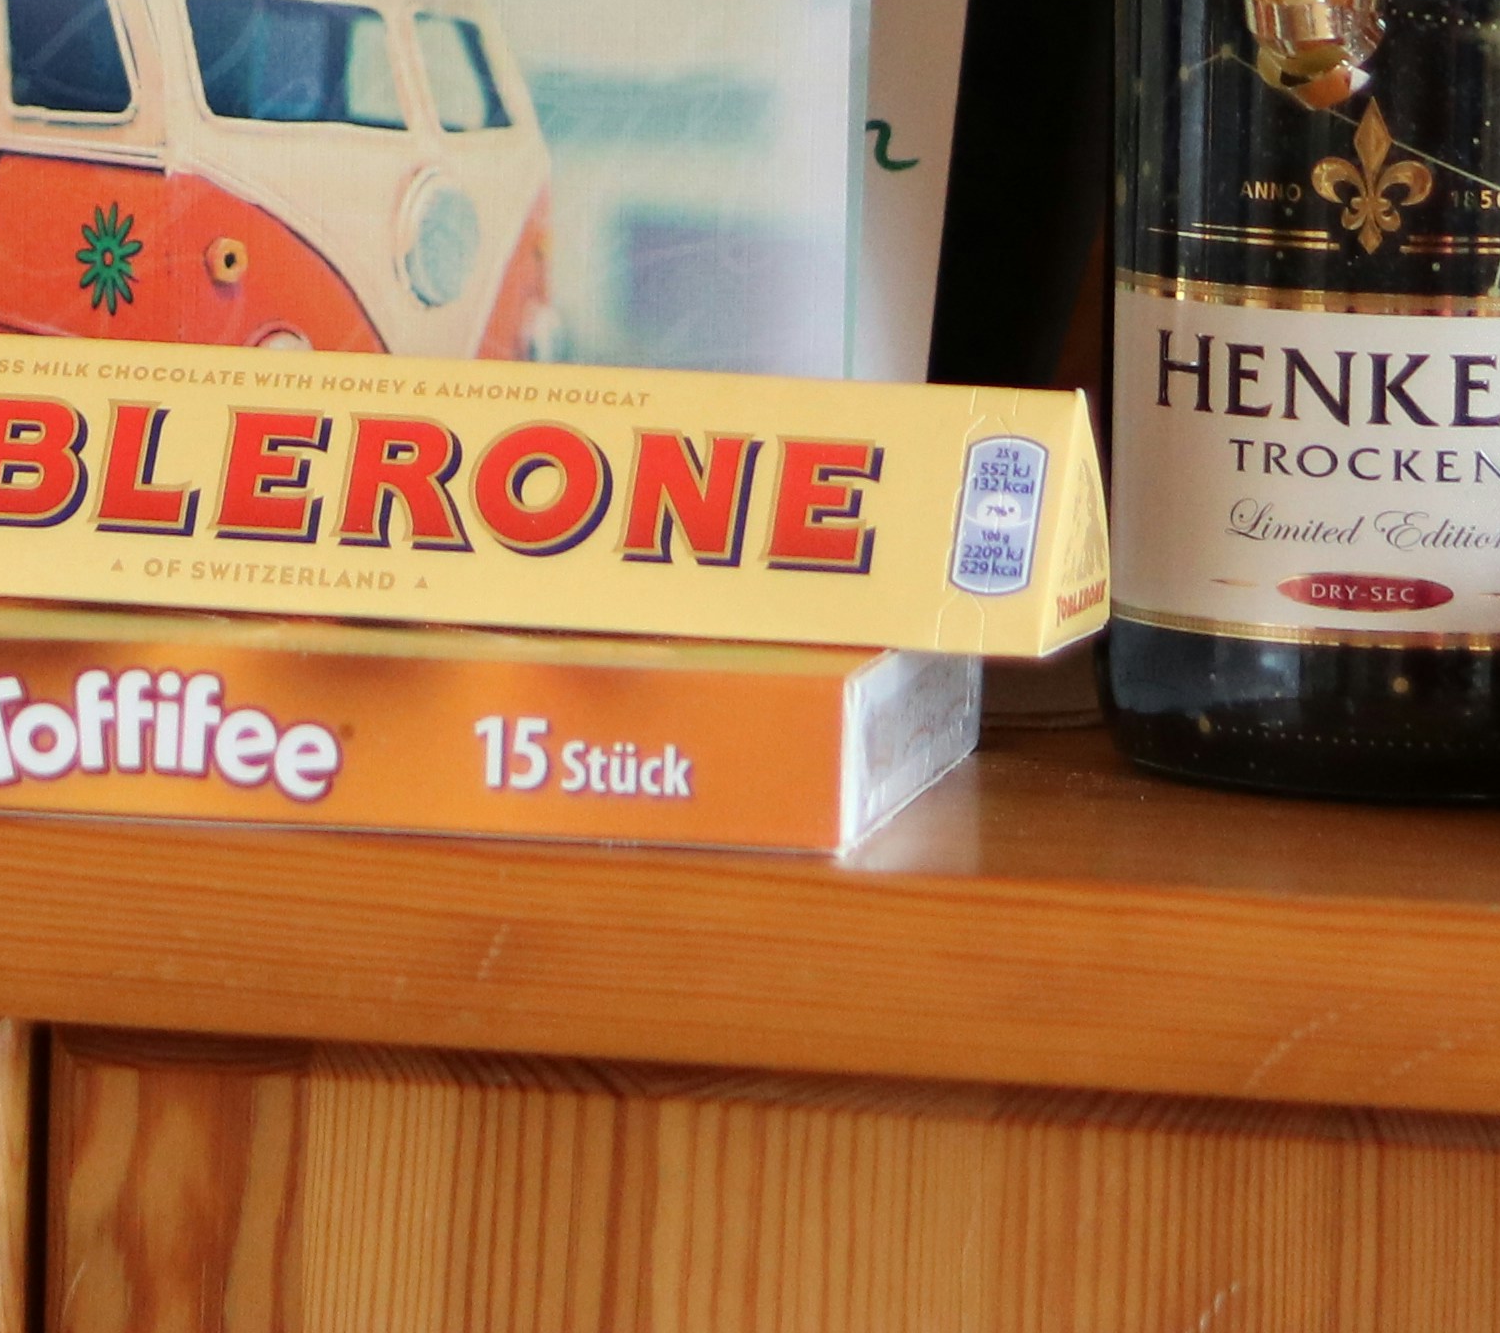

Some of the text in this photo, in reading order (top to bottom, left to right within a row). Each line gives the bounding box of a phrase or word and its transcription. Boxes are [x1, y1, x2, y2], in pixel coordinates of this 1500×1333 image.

[1241, 179, 1301, 202] ANNO
[33, 360, 89, 378] MILK
[98, 363, 246, 386] CHOCOLATE
[254, 371, 314, 391] WITH
[321, 376, 406, 396] HONEY
[412, 380, 428, 397] &
[435, 381, 539, 402] ALMOND
[547, 388, 651, 408] NOUGAT
[1003, 479, 1035, 495] kcal
[1224, 496, 1360, 548] Limited
[144, 557, 397, 591] OF SWITZERLAND
[960, 561, 1024, 578] 529 kcal
[1309, 582, 1417, 606] DRY-SEC
[474, 714, 693, 799] 15 Stück
